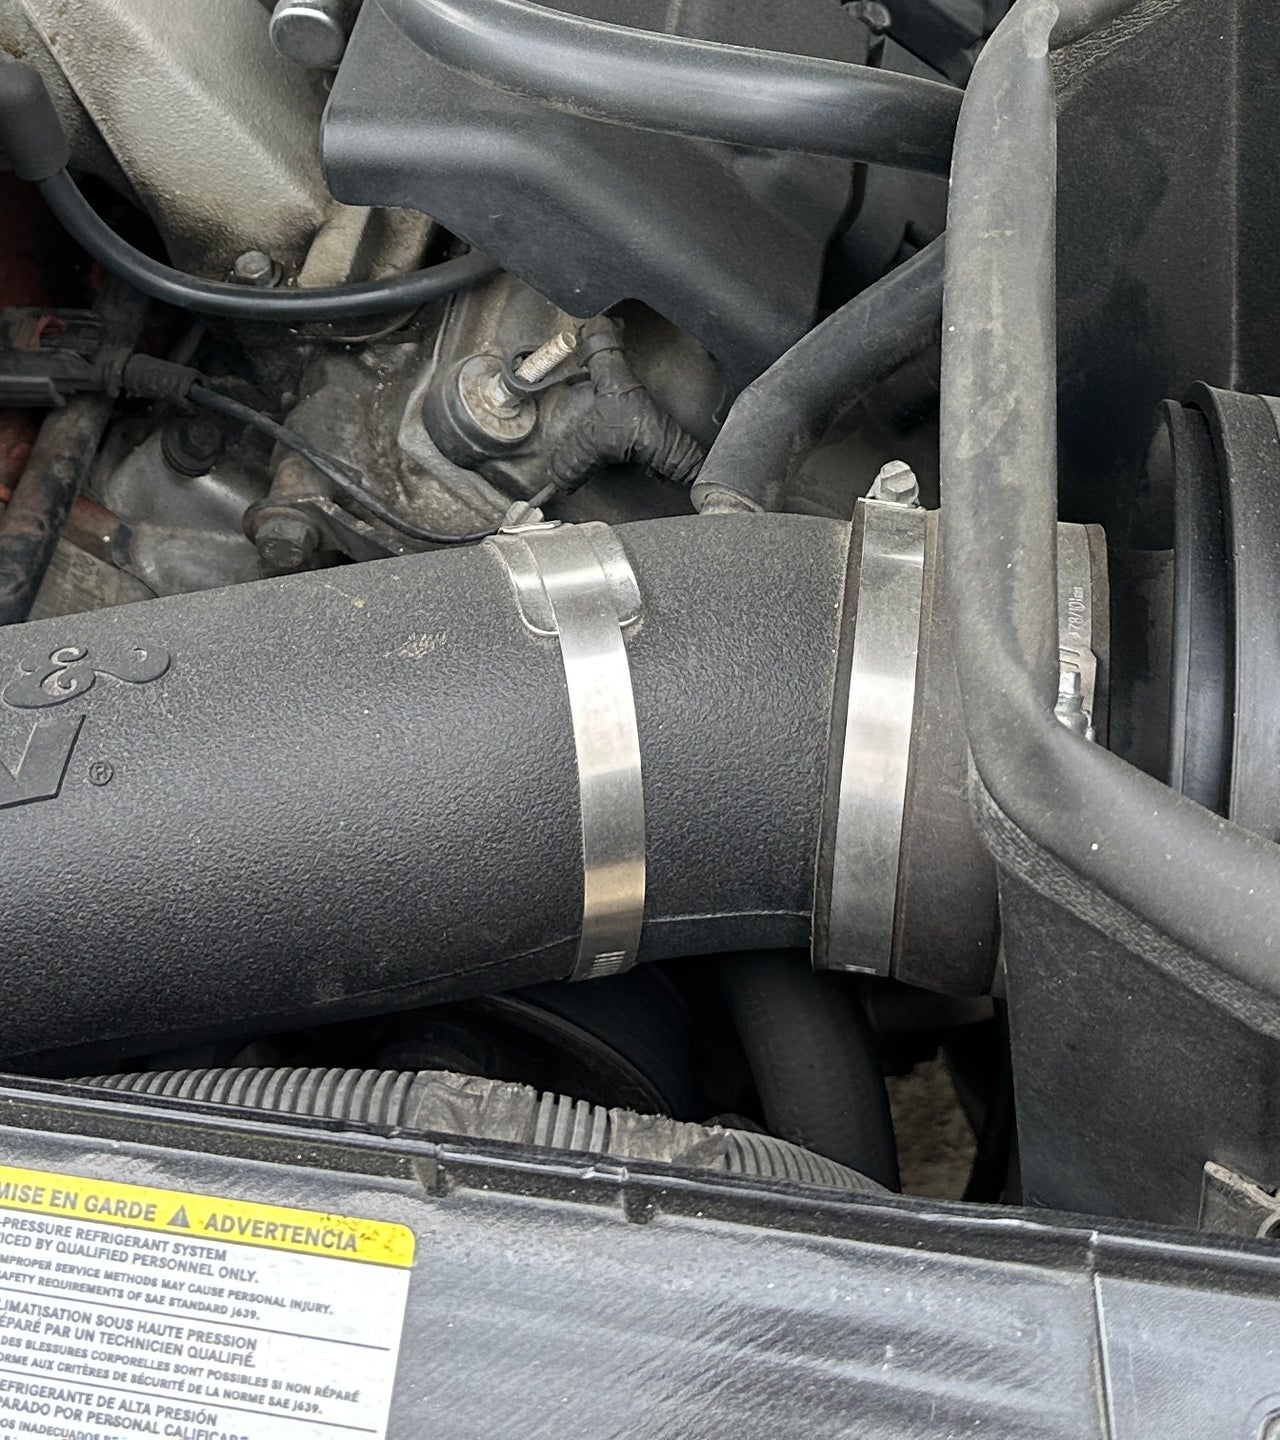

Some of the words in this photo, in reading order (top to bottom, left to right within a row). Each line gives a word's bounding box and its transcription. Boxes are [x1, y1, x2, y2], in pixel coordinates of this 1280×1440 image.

[48, 1188, 79, 1211] EN
[83, 1194, 158, 1223] GARDE
[203, 1211, 360, 1255] ADVERTENCIA
[34, 1237, 54, 1251] BY
[55, 1240, 129, 1263] QUALIFIED
[131, 1251, 215, 1277] PERSONNEL
[74, 1226, 170, 1253] REFRIGERANT
[171, 1241, 228, 1262] SYSTEM
[36, 1275, 125, 1299] REQUIREMENTS
[126, 1289, 143, 1302] OF
[143, 1292, 166, 1306] SAE
[167, 1296, 229, 1315] STANDARD
[53, 1261, 102, 1279] SERVICE
[102, 1269, 159, 1288] METHODS
[160, 1278, 186, 1292] MAY
[187, 1282, 226, 1298] CAUSE
[226, 1288, 287, 1308] PERSONAL
[43, 1322, 72, 1339] PAR
[73, 1326, 96, 1343] UN
[98, 1330, 184, 1357] TECHNICIEN
[94, 1313, 135, 1332] SOUS
[136, 1319, 185, 1340] HAUTE
[185, 1327, 258, 1351] PRESSION
[0, 1334, 23, 1349] DES
[24, 1338, 89, 1359] BLESSURES
[90, 1349, 171, 1373] CORPORELLES
[172, 1362, 205, 1378] SONT
[205, 1368, 269, 1389] POSSIBLES
[270, 1378, 283, 1390] SI
[284, 1381, 312, 1395] NON
[313, 1384, 360, 1403] RÉPARÉ
[29, 1357, 55, 1371] AUX
[56, 1361, 110, 1380] CRITÈRES
[111, 1369, 129, 1383] DE
[129, 1371, 186, 1392] SÉCURITÉ
[186, 1382, 204, 1395] DE
[204, 1385, 220, 1398] LA
[222, 1388, 266, 1405] NORME
[267, 1395, 291, 1409] SAE
[53, 1404, 84, 1422] POR
[85, 1409, 161, 1435] PERSONAL
[95, 1394, 117, 1410] DE
[116, 1398, 152, 1416] ALTA
[154, 1404, 218, 1427] PRESIÓN
